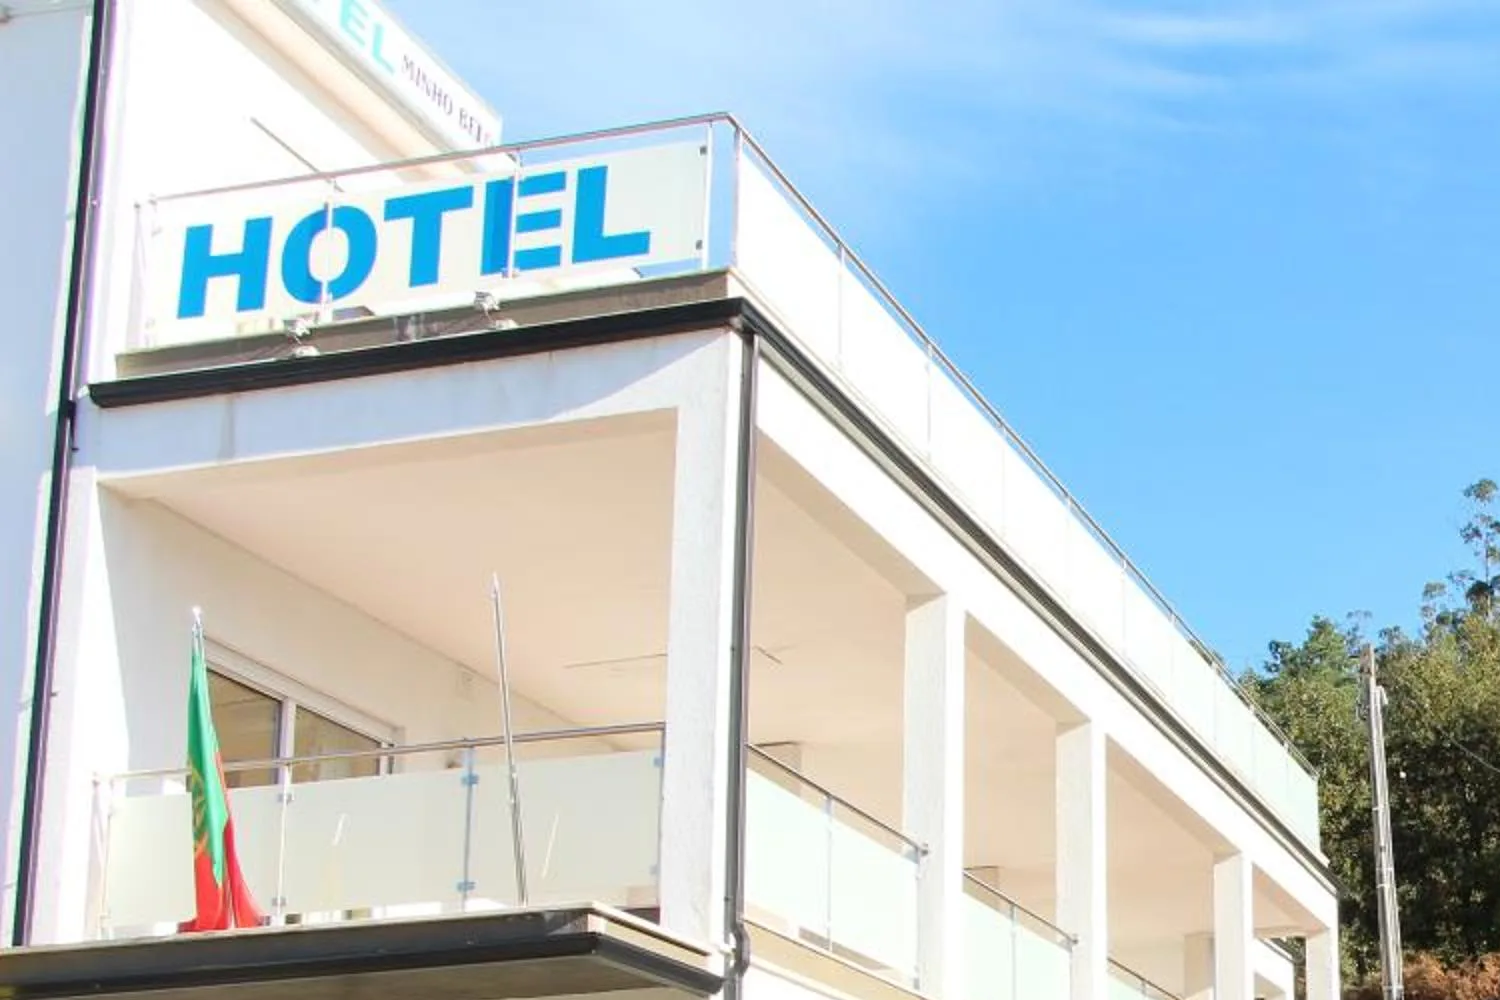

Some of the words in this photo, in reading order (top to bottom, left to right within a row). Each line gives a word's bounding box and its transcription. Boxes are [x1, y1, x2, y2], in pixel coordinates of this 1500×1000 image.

[315, 0, 395, 76] EL
[401, 54, 453, 116] MINHO
[178, 165, 650, 318] HOTEL
